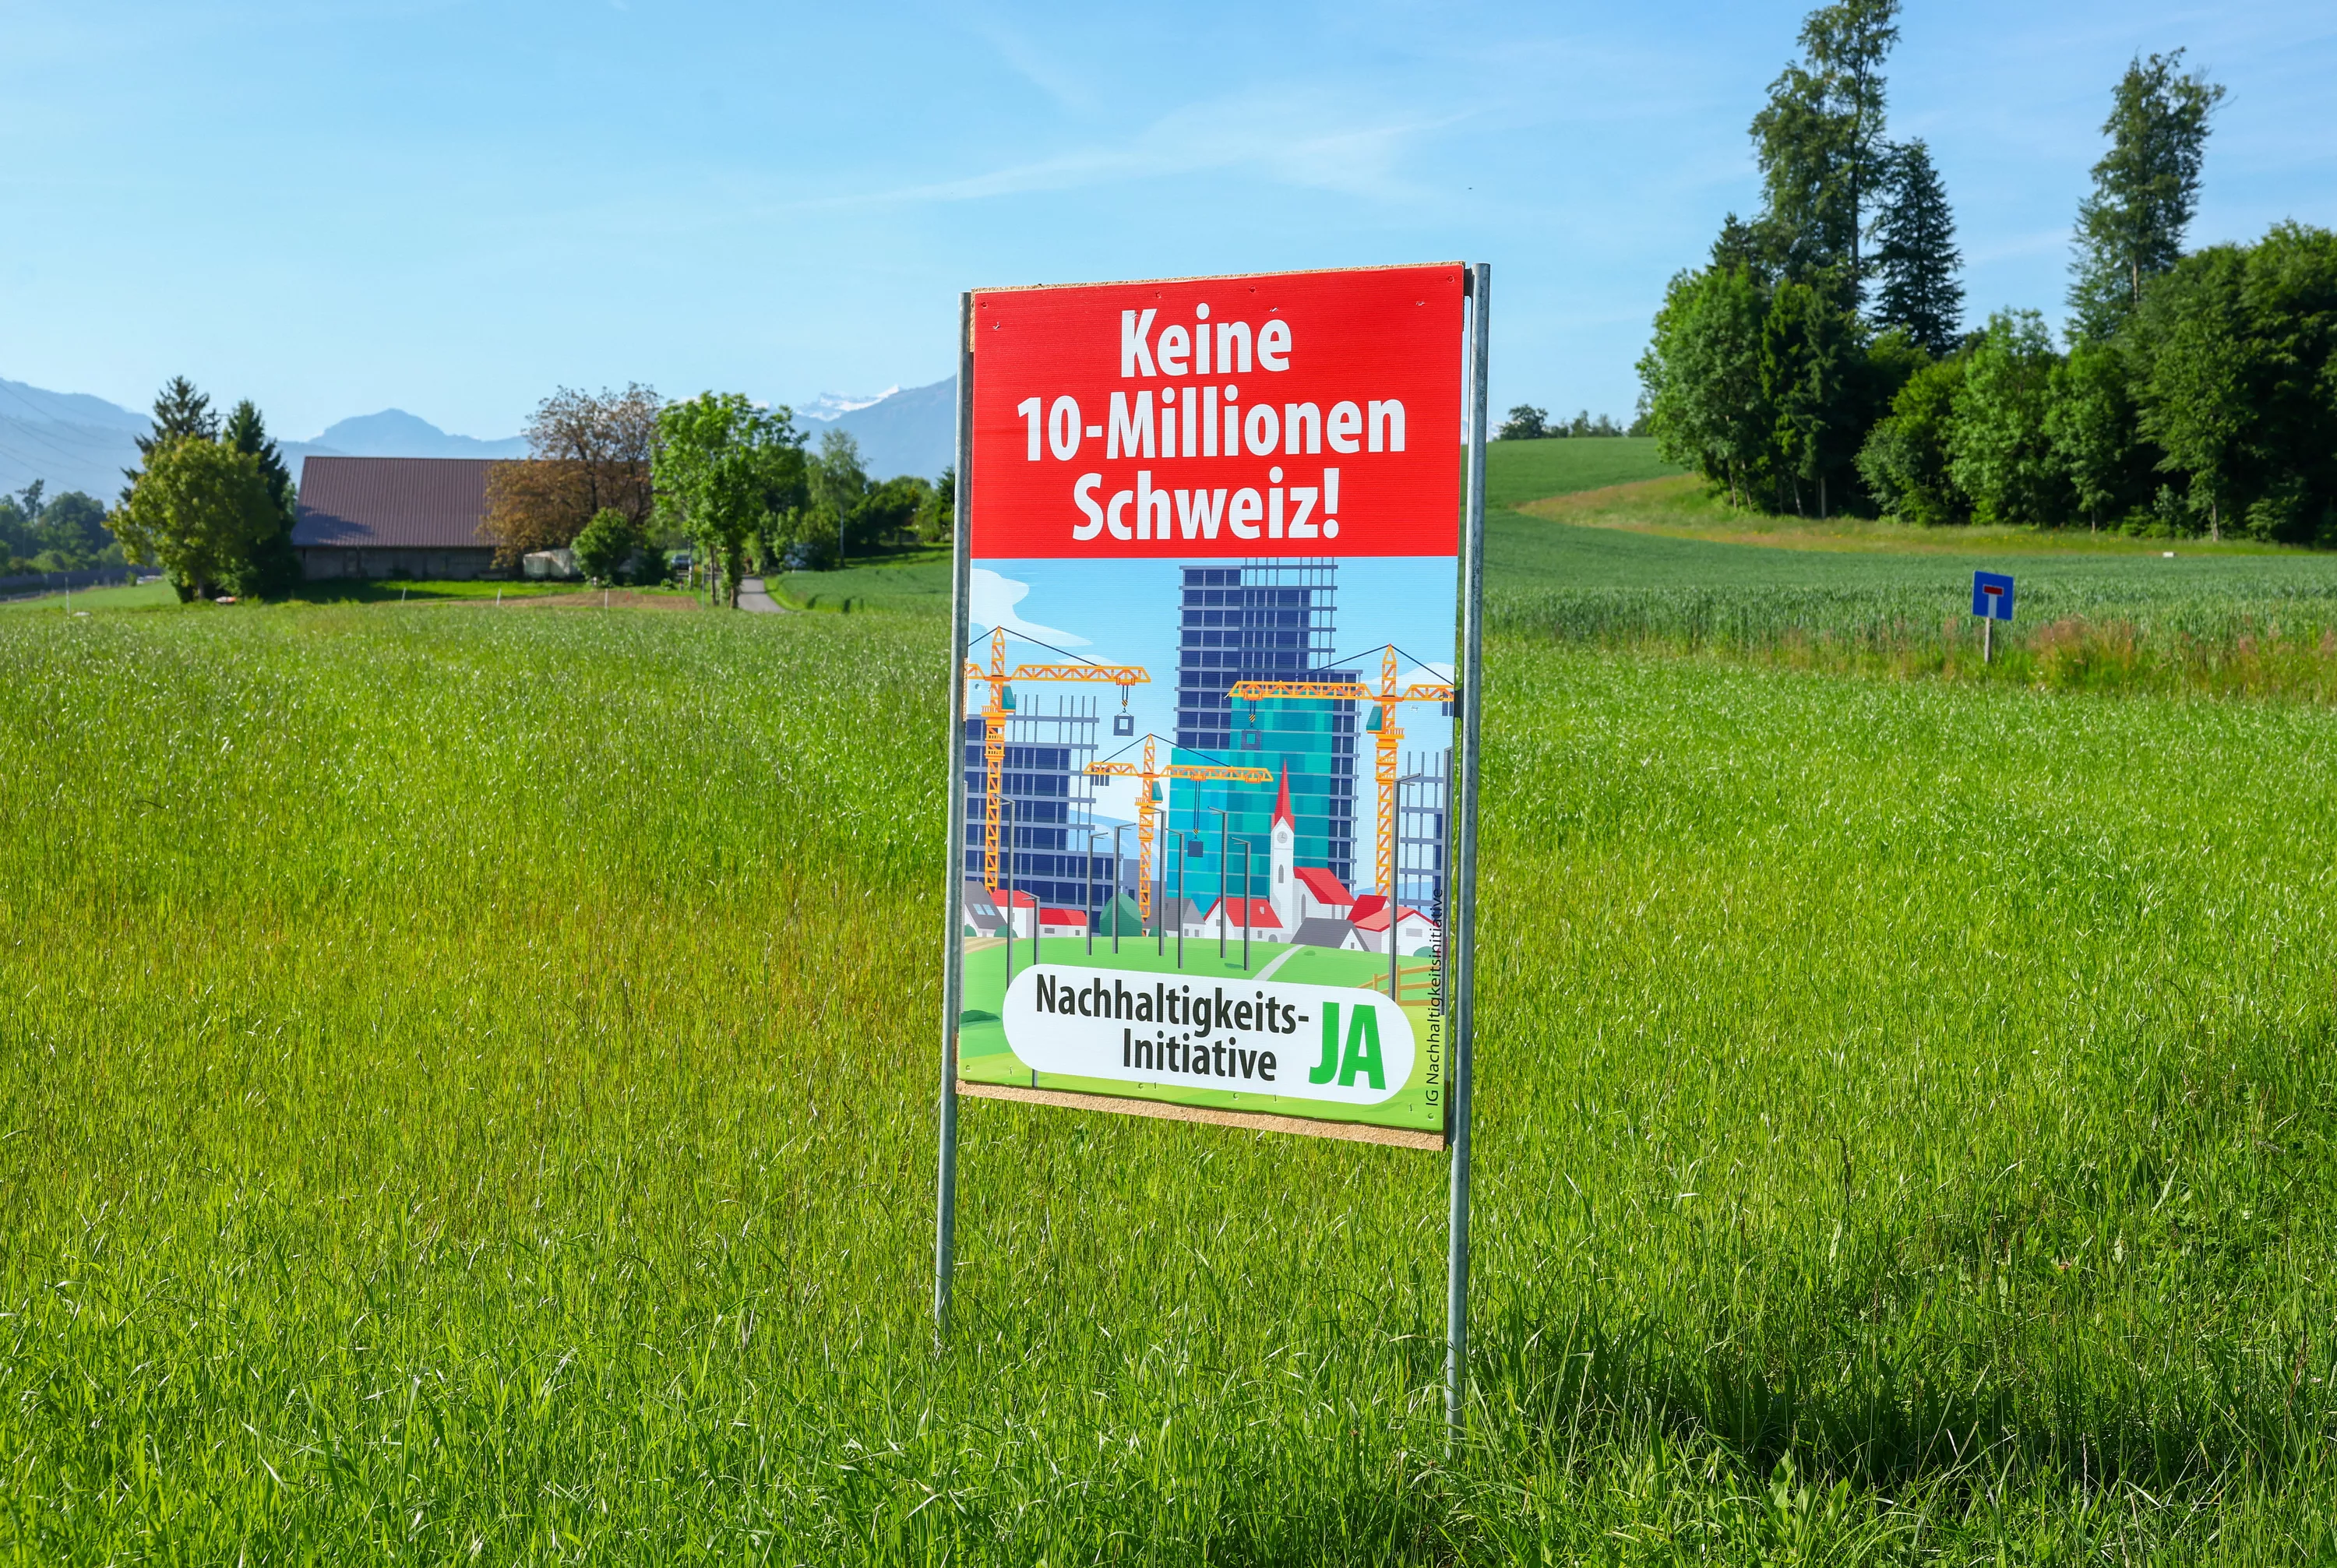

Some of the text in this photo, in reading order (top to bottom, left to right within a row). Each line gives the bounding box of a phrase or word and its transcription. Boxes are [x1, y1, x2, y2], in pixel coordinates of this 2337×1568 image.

[1120, 302, 1293, 379] Keine
[1017, 384, 1406, 461] 10-Millionen
[1072, 466, 1341, 541] Schweiz!
[1035, 974, 1310, 1038] Nachhaltigkeits-
[1426, 888, 1445, 1106] IG Nachhaltigkeitsinitiative
[1123, 1028, 1278, 1081] Initiative
[1309, 1001, 1387, 1091] JA
